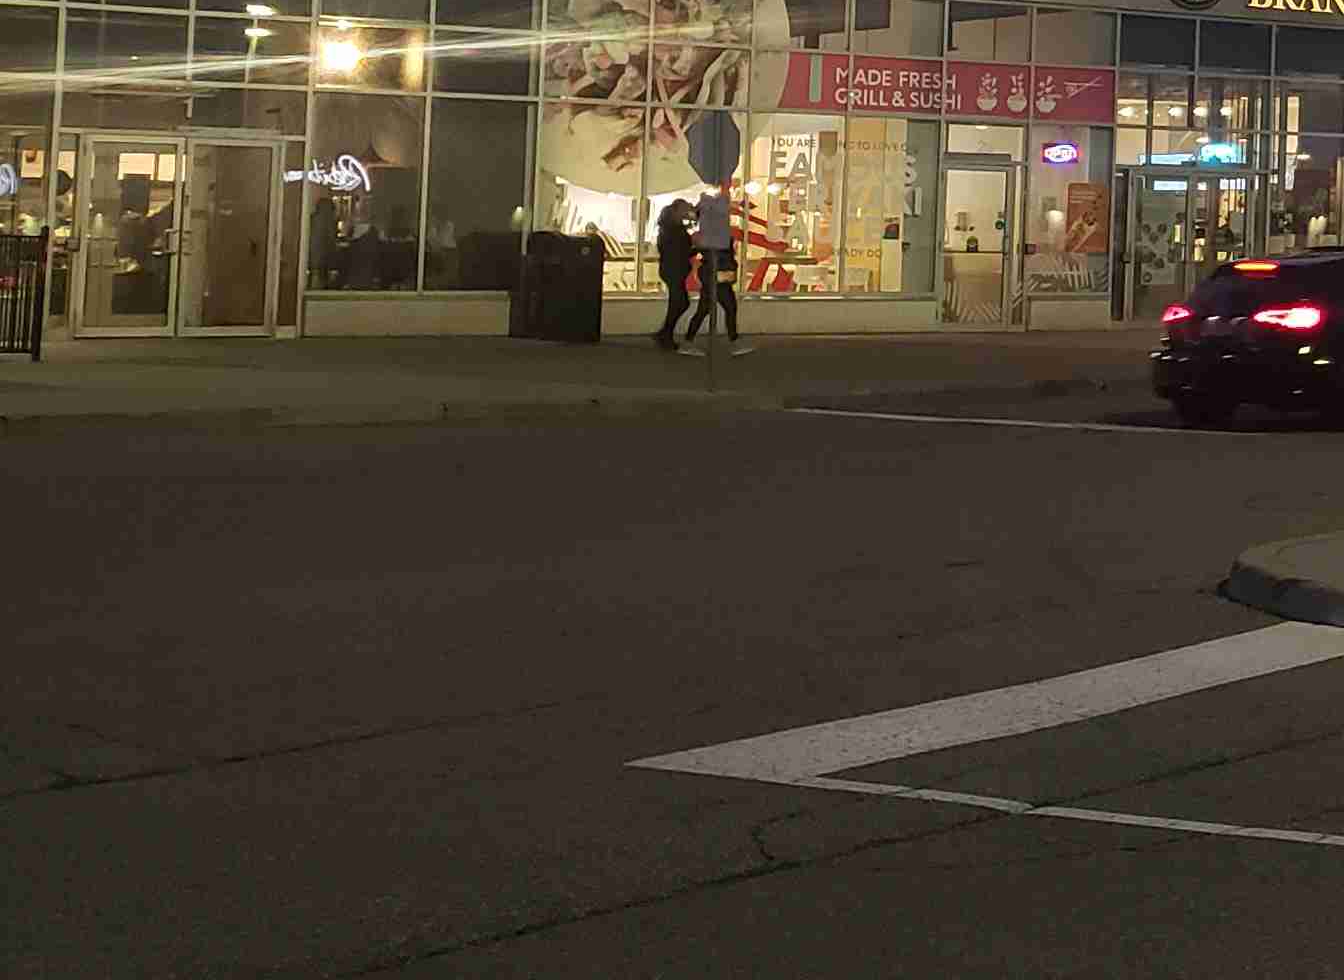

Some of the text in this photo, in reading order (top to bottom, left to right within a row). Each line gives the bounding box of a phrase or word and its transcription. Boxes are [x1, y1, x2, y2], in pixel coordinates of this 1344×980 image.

[835, 67, 957, 91] MADE FRESH
[834, 88, 961, 111] GRILL & SUSHI
